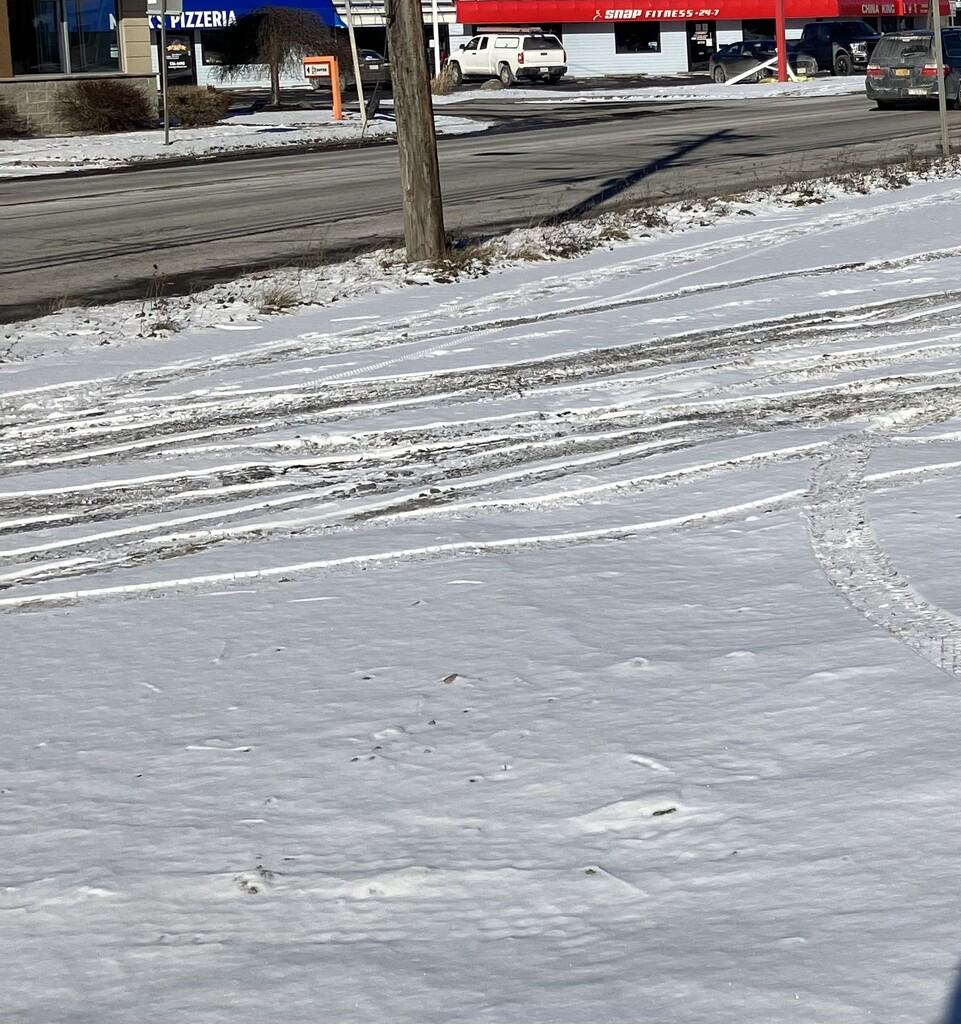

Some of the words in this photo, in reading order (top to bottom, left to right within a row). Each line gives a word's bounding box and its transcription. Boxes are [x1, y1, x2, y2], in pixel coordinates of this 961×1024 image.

[862, 3, 879, 14] CHINA
[881, 3, 895, 14] KING
[170, 10, 237, 29] PIZZERIA
